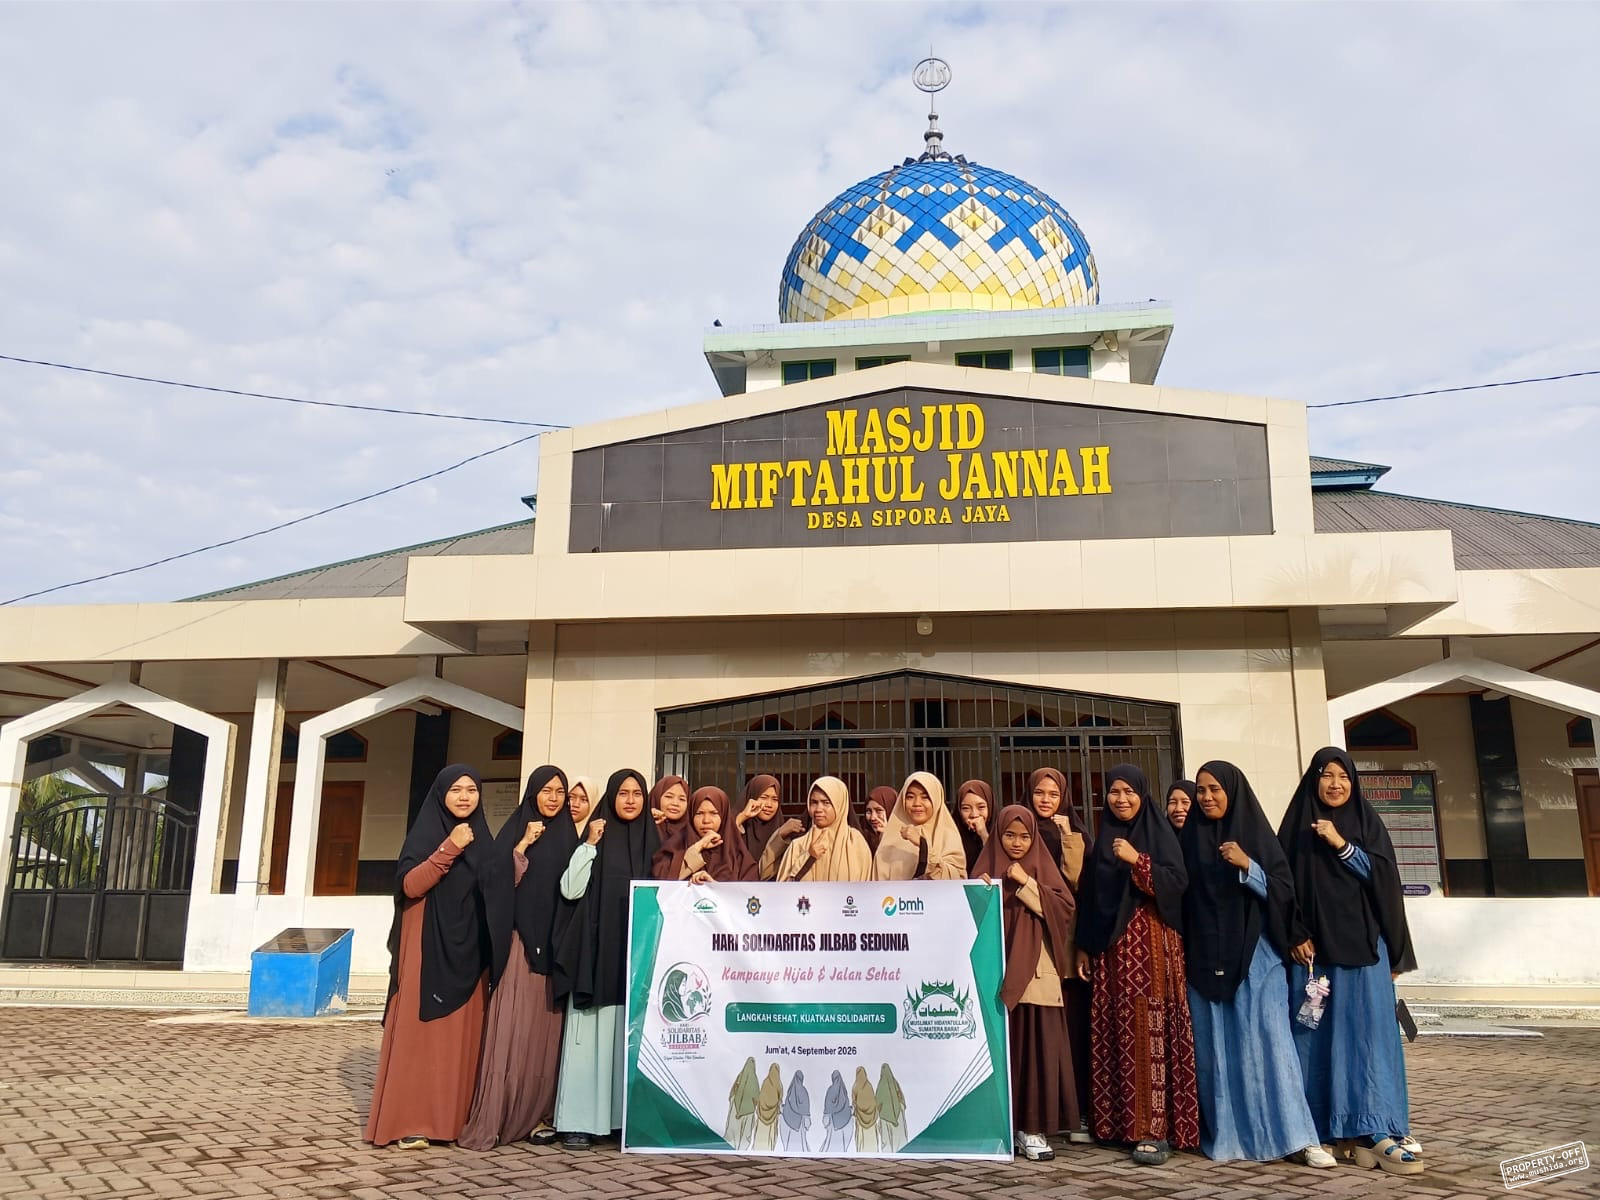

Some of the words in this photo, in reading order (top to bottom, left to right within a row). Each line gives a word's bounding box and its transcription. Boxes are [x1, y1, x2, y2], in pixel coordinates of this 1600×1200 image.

[826, 403, 985, 456] MASJID
[711, 456, 925, 510] MIFTAHUL
[938, 446, 1112, 500] JANNAH
[807, 511, 863, 529] DESA
[872, 507, 953, 527] SIPORA
[961, 505, 1011, 523] JAYA
[898, 897, 924, 911] bmh
[712, 933, 739, 951] HARI
[742, 933, 816, 951] SOLIDARITAS
[819, 933, 857, 951] JILBAB
[860, 933, 910, 951] SEDUNIA
[721, 966, 780, 984] Kampanye
[783, 966, 814, 984] Hijab
[817, 966, 826, 982] &
[829, 967, 862, 982] Jalan
[865, 967, 901, 982] Sehat
[736, 1013, 772, 1022] LANGKAH
[773, 1014, 799, 1024] SEHAT,
[800, 1013, 836, 1023] KUATKAN
[836, 1014, 886, 1023] SOLIDARITAS
[667, 1033, 702, 1043] JILBAB
[765, 1046, 790, 1055] Jum'at,
[797, 1046, 837, 1056] September
[837, 1047, 857, 1055] 2026
